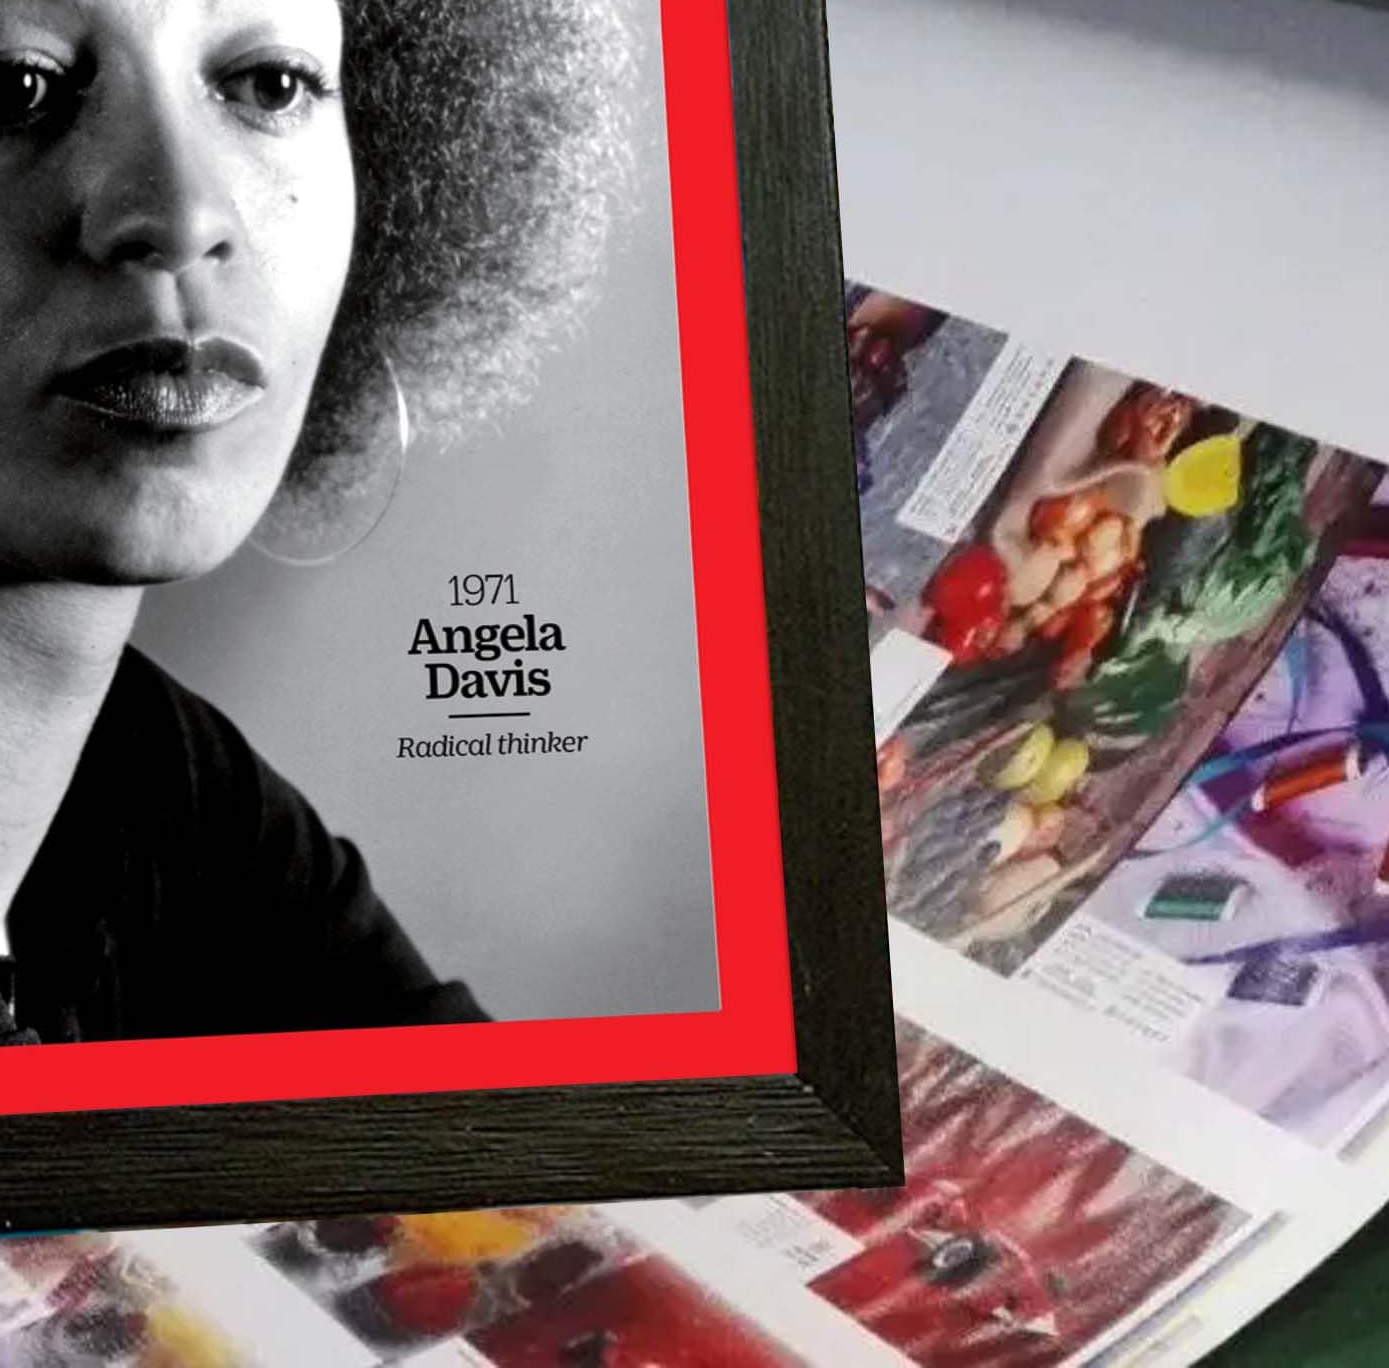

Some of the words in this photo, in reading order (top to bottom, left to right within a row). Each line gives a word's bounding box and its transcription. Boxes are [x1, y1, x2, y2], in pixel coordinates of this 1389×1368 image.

[448, 574, 520, 607] 1971
[407, 613, 567, 661] Angela
[424, 659, 552, 700] Davis
[396, 733, 492, 759] Radical
[497, 731, 590, 756] thinker
